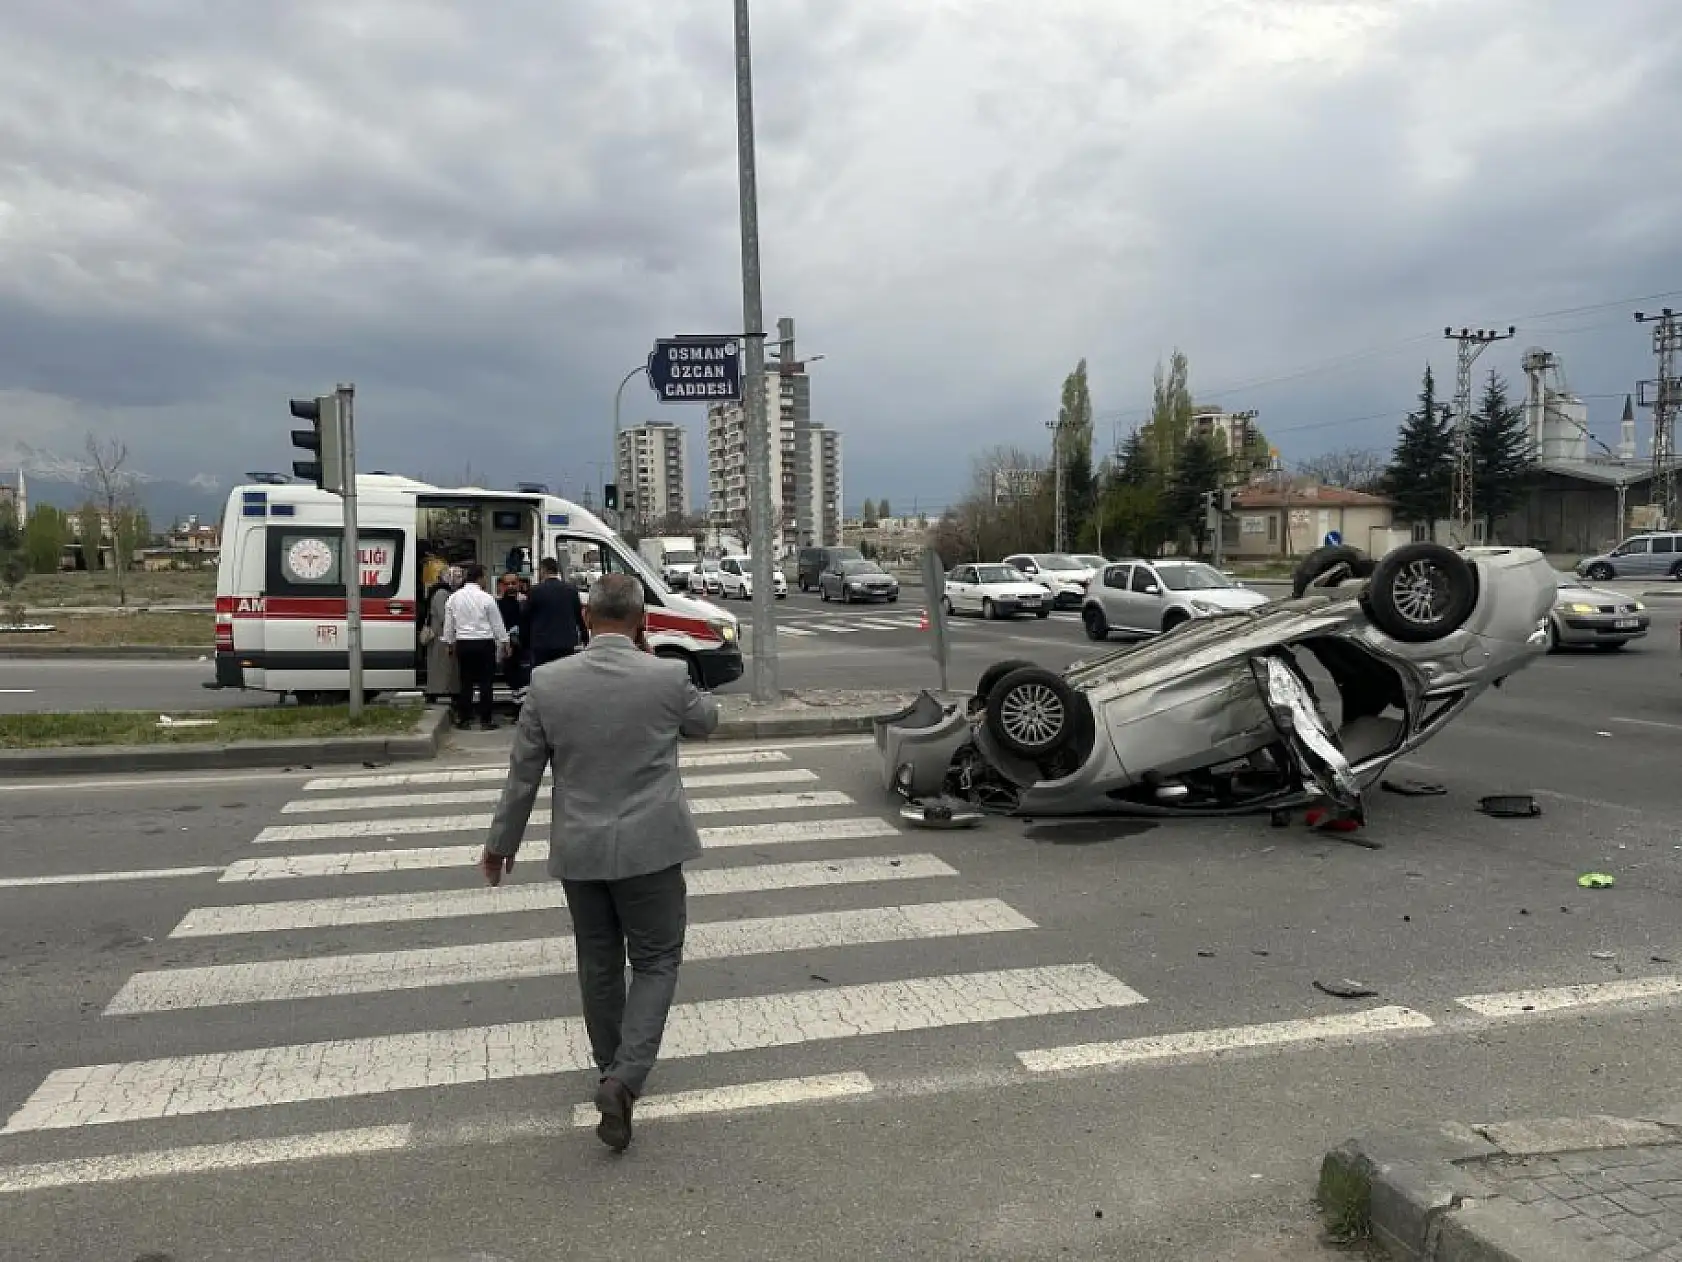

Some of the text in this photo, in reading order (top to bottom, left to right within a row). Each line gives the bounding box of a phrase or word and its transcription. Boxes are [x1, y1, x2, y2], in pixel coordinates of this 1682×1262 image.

[668, 347, 724, 361] OSMAN
[671, 362, 724, 378] ÖZCAN
[665, 379, 734, 396] CADDESİ
